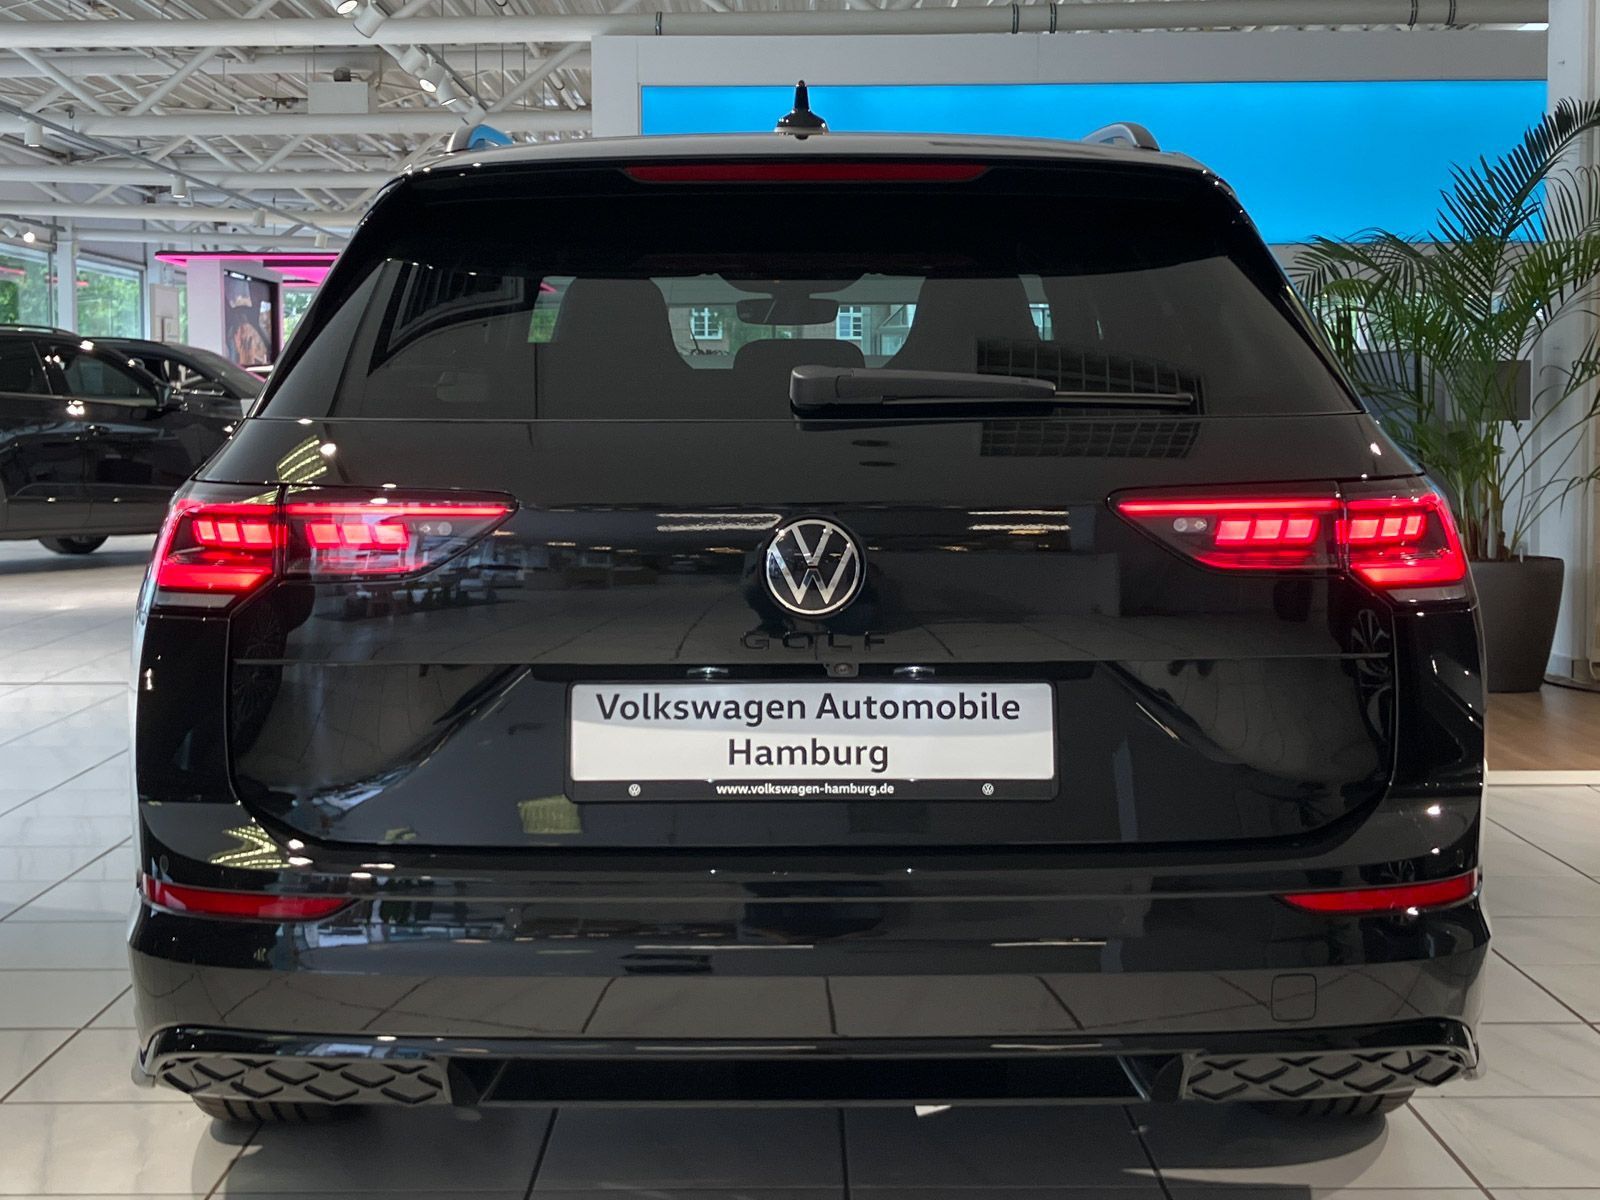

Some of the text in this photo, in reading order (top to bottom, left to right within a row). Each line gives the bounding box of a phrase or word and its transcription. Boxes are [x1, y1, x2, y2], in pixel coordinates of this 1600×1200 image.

[740, 631, 886, 651] GOLF
[596, 692, 1021, 727] Volkswagen Automobile
[728, 738, 889, 773] Hamburg
[716, 783, 895, 797] www.volkswagen-hamburg.de
